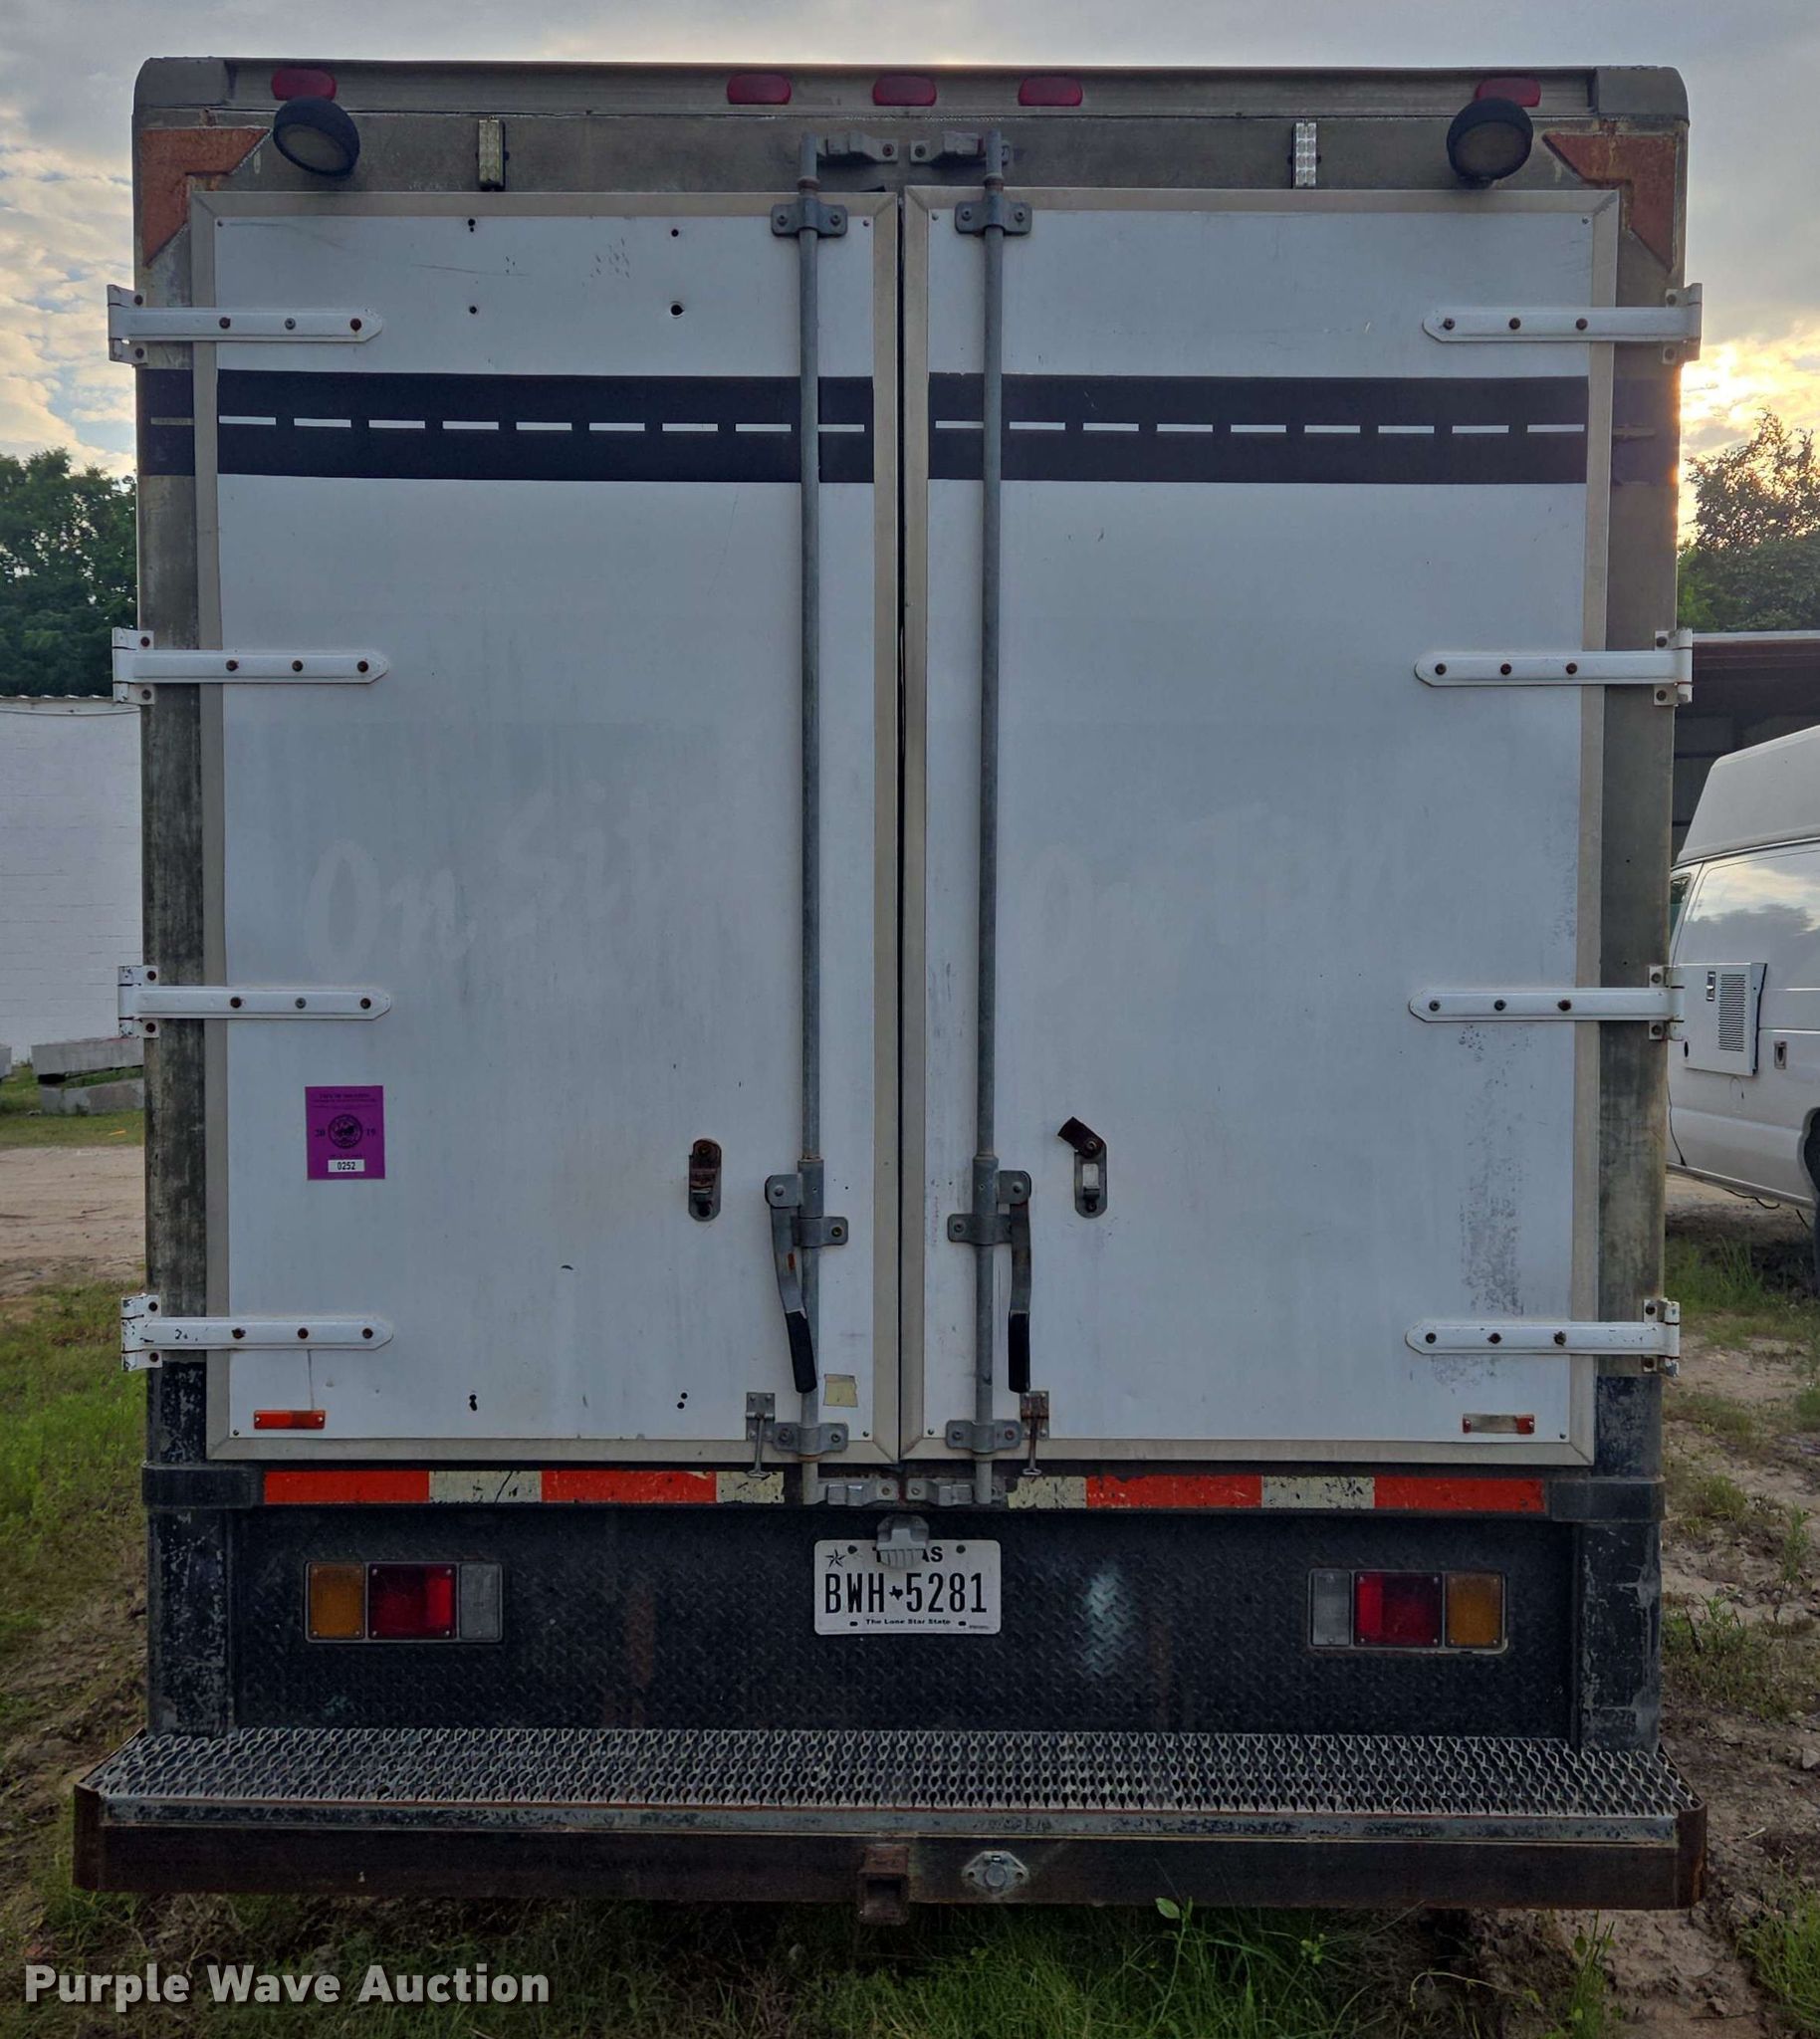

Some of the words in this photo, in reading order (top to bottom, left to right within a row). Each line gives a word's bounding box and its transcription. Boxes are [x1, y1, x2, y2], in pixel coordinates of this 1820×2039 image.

[337, 1161, 356, 1171] 0252
[824, 1573, 884, 1613] BWH
[906, 1572, 987, 1613] 5281
